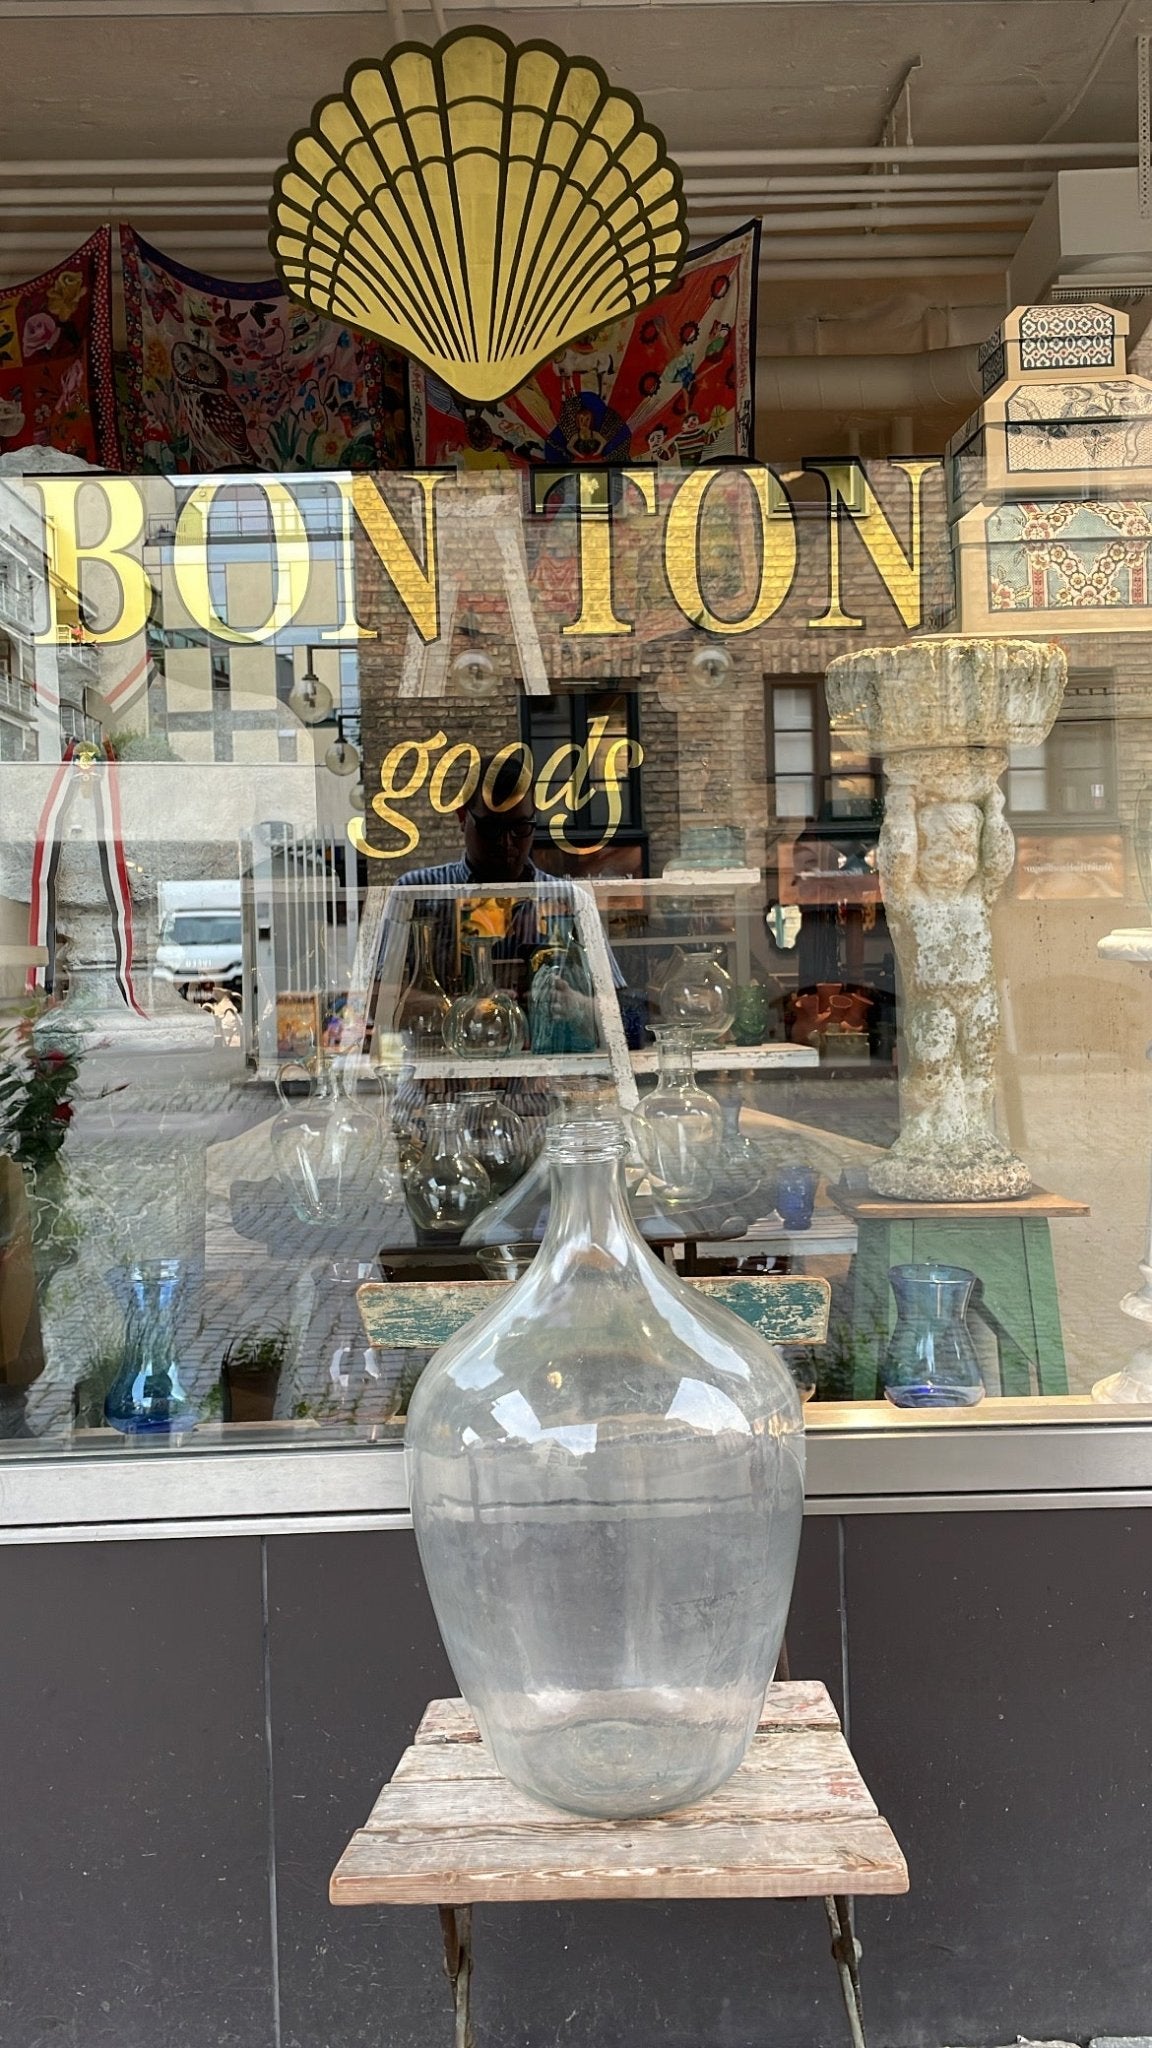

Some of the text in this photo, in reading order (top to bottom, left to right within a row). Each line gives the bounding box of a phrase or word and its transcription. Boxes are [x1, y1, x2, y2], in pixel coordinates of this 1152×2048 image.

[28, 460, 942, 646] BON TON
[346, 715, 645, 859] goods
